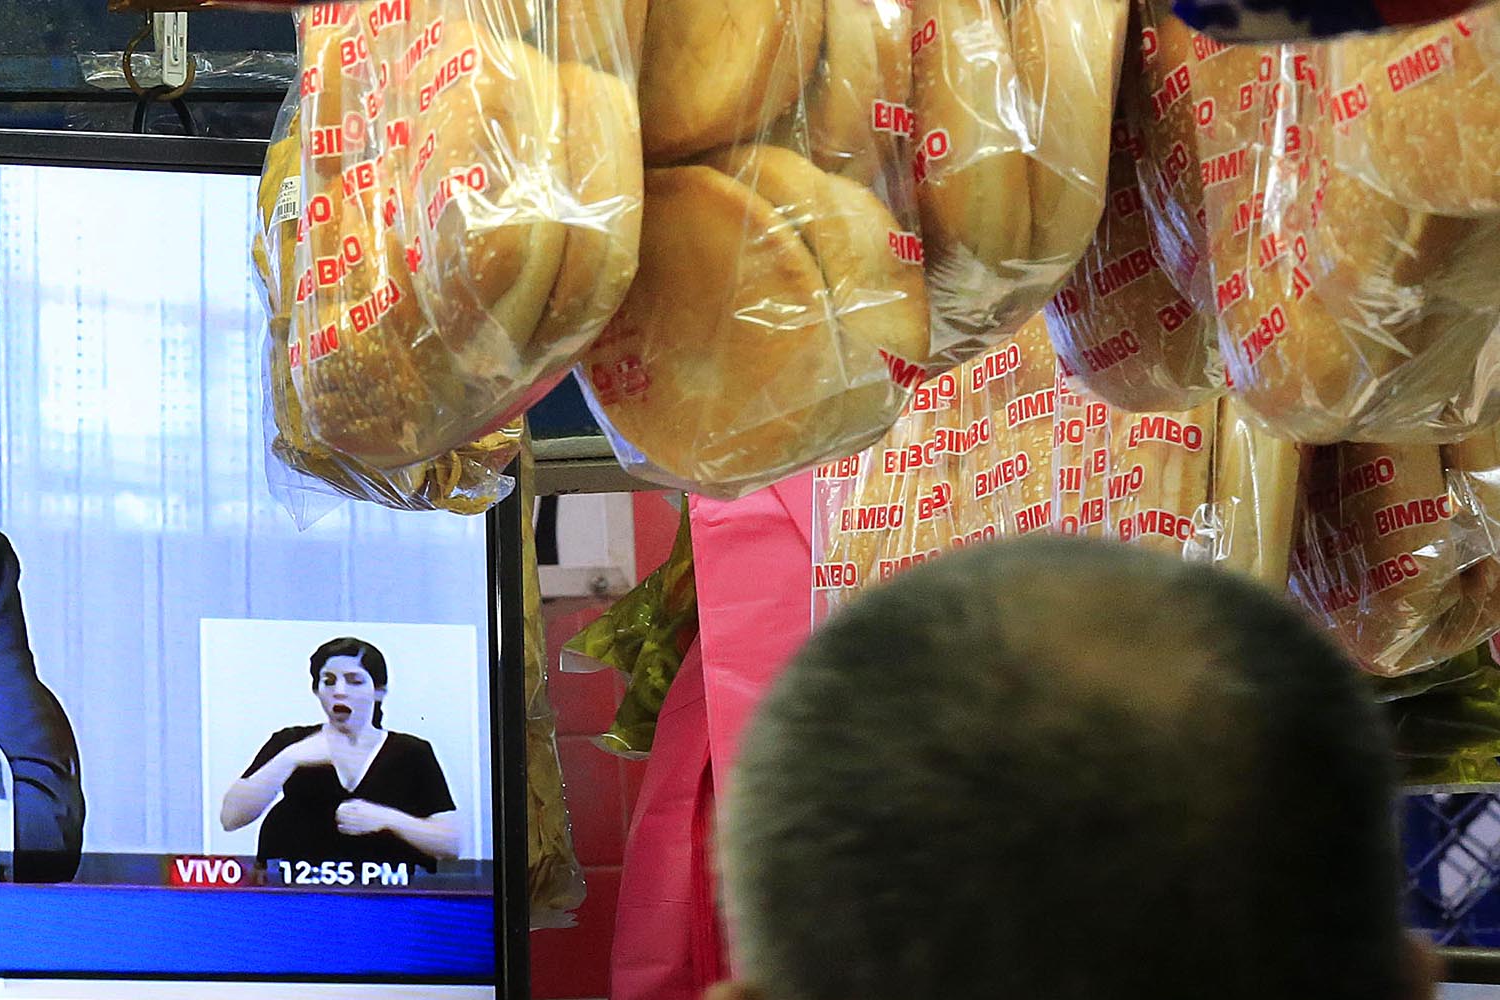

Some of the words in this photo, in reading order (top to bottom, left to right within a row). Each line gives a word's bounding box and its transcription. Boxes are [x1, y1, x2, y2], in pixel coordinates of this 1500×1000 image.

[841, 505, 904, 531] BIMBO
[176, 859, 242, 884] VIVO
[279, 860, 355, 885] 12:55
[361, 861, 409, 886] PM
